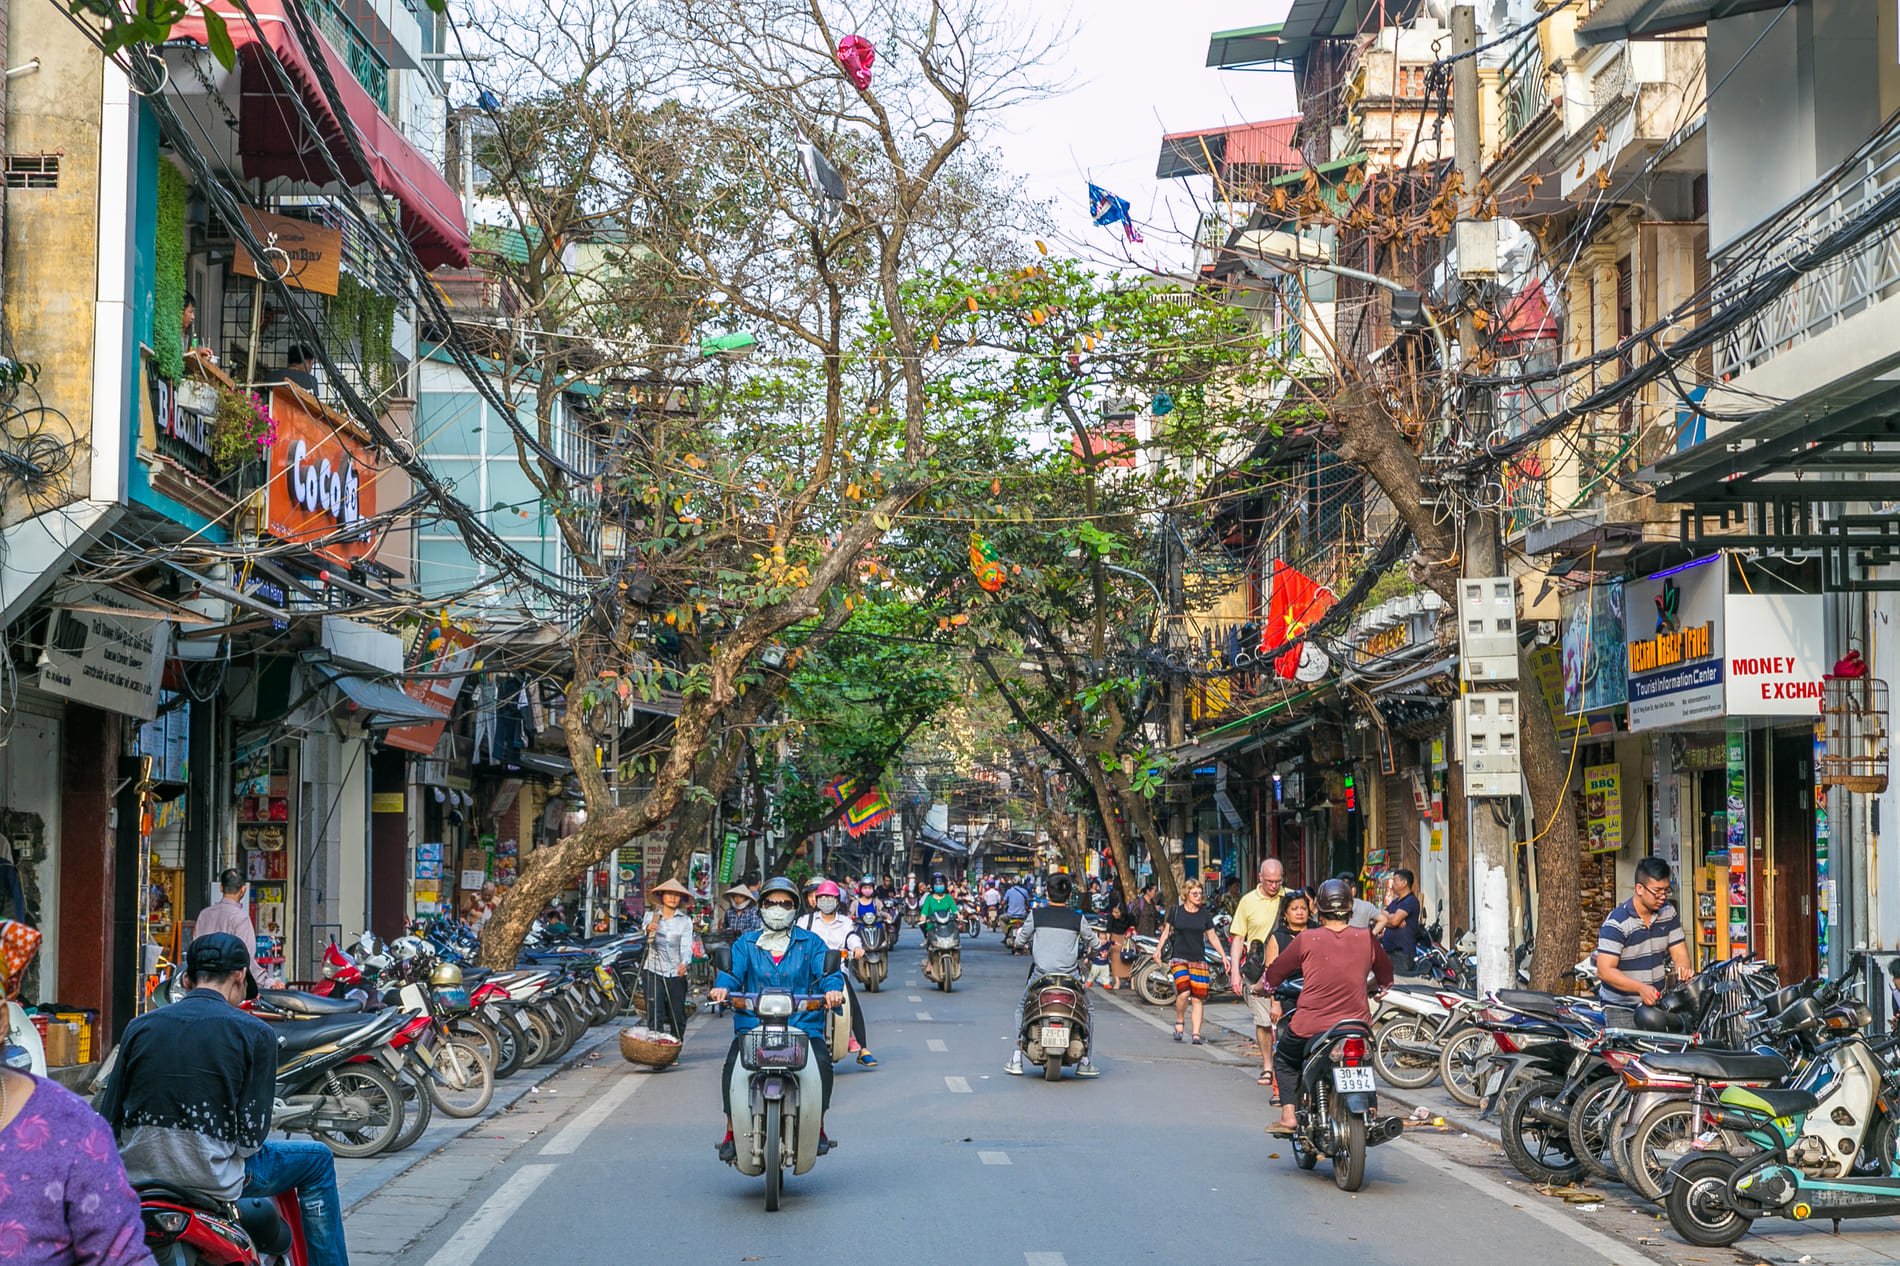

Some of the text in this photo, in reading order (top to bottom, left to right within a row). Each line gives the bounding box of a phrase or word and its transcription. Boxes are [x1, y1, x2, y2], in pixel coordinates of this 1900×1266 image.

[1629, 621, 1709, 673] Vietnam Master Travel
[1732, 657, 1795, 676] MONEY
[1636, 667, 1717, 696] Tourist Information Center
[1590, 778, 1615, 790] BBQ
[1341, 1079, 1370, 1089] 3994
